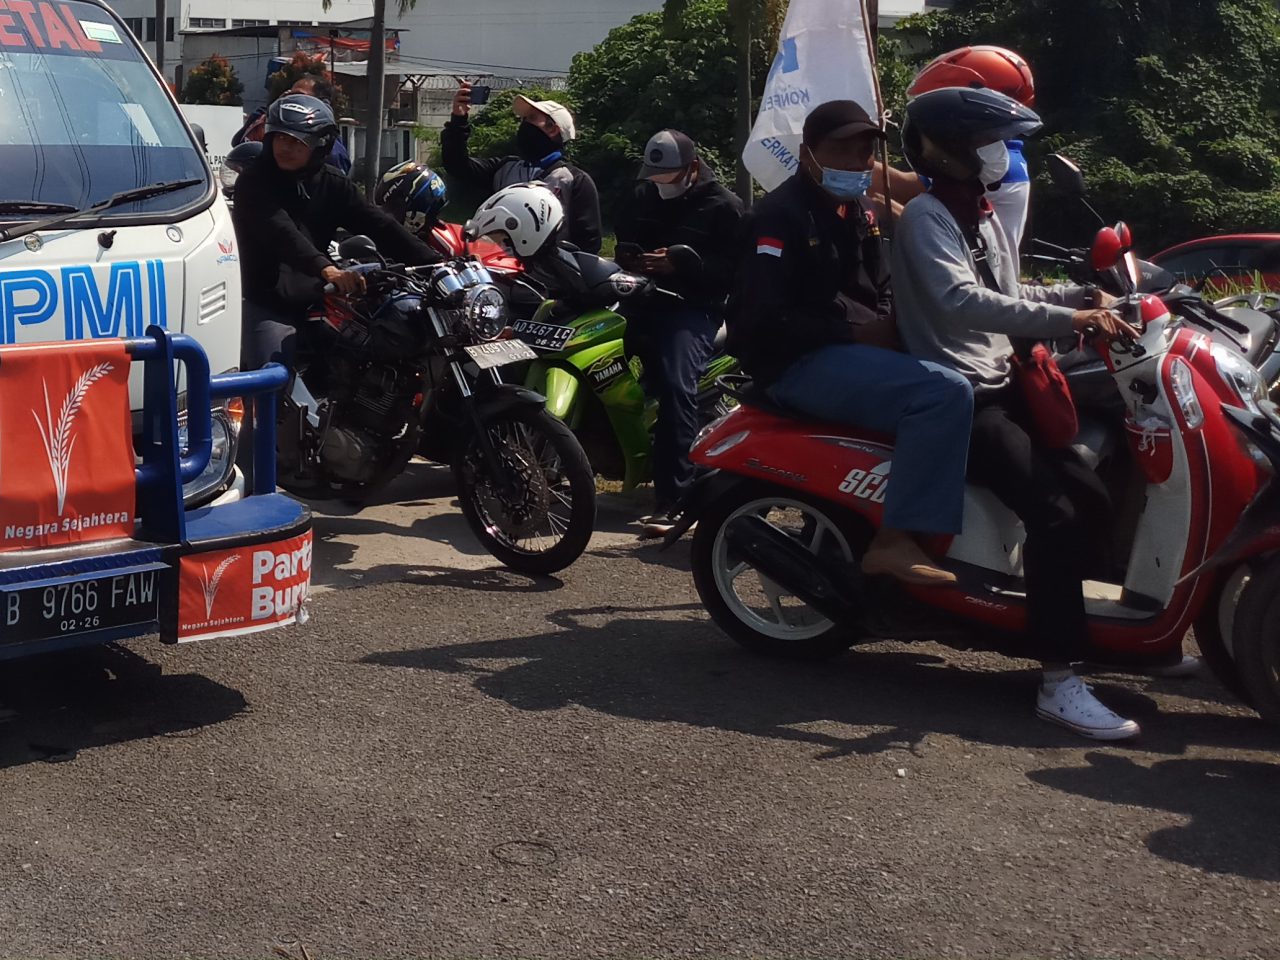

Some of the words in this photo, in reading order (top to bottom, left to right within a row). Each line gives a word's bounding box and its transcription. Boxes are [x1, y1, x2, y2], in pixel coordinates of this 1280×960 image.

[594, 362, 623, 383] YAMAHA
[4, 522, 58, 540] Negara
[61, 511, 129, 531] Sejahtera
[6, 592, 21, 626] B
[42, 580, 98, 620] 9766
[111, 571, 155, 609] FAW
[181, 621, 209, 632] Negara
[209, 616, 246, 628] Sejahtera
